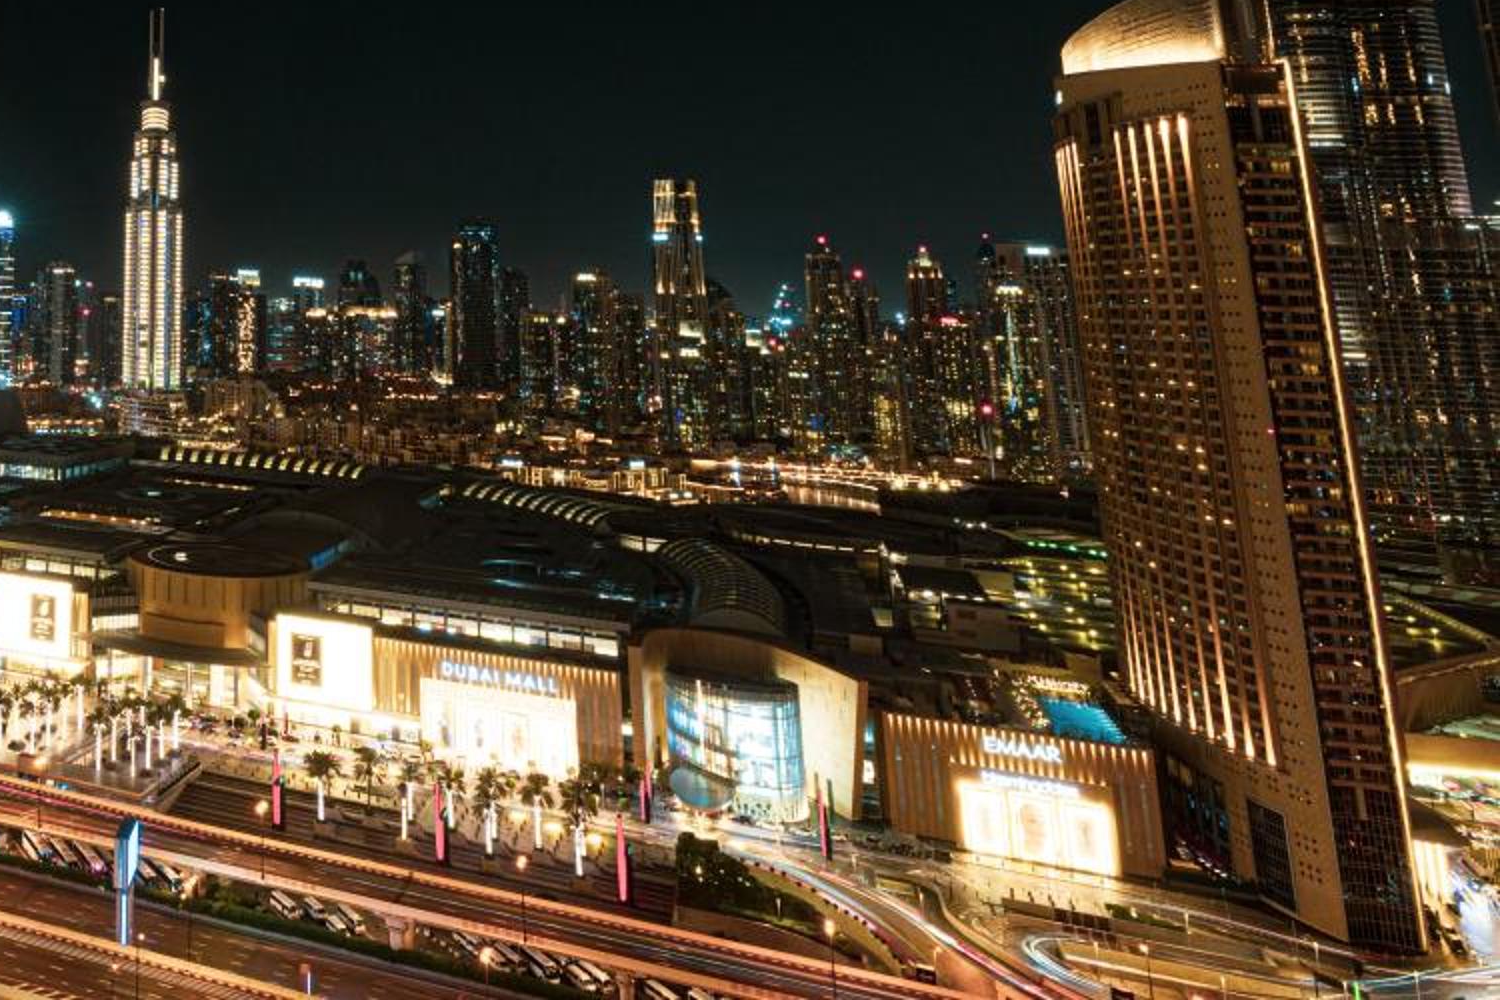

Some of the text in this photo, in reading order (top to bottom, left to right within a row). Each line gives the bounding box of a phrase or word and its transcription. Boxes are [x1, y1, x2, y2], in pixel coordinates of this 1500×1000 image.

[441, 659, 559, 694] DUBAI MALL
[982, 735, 1062, 764] EMAAR
